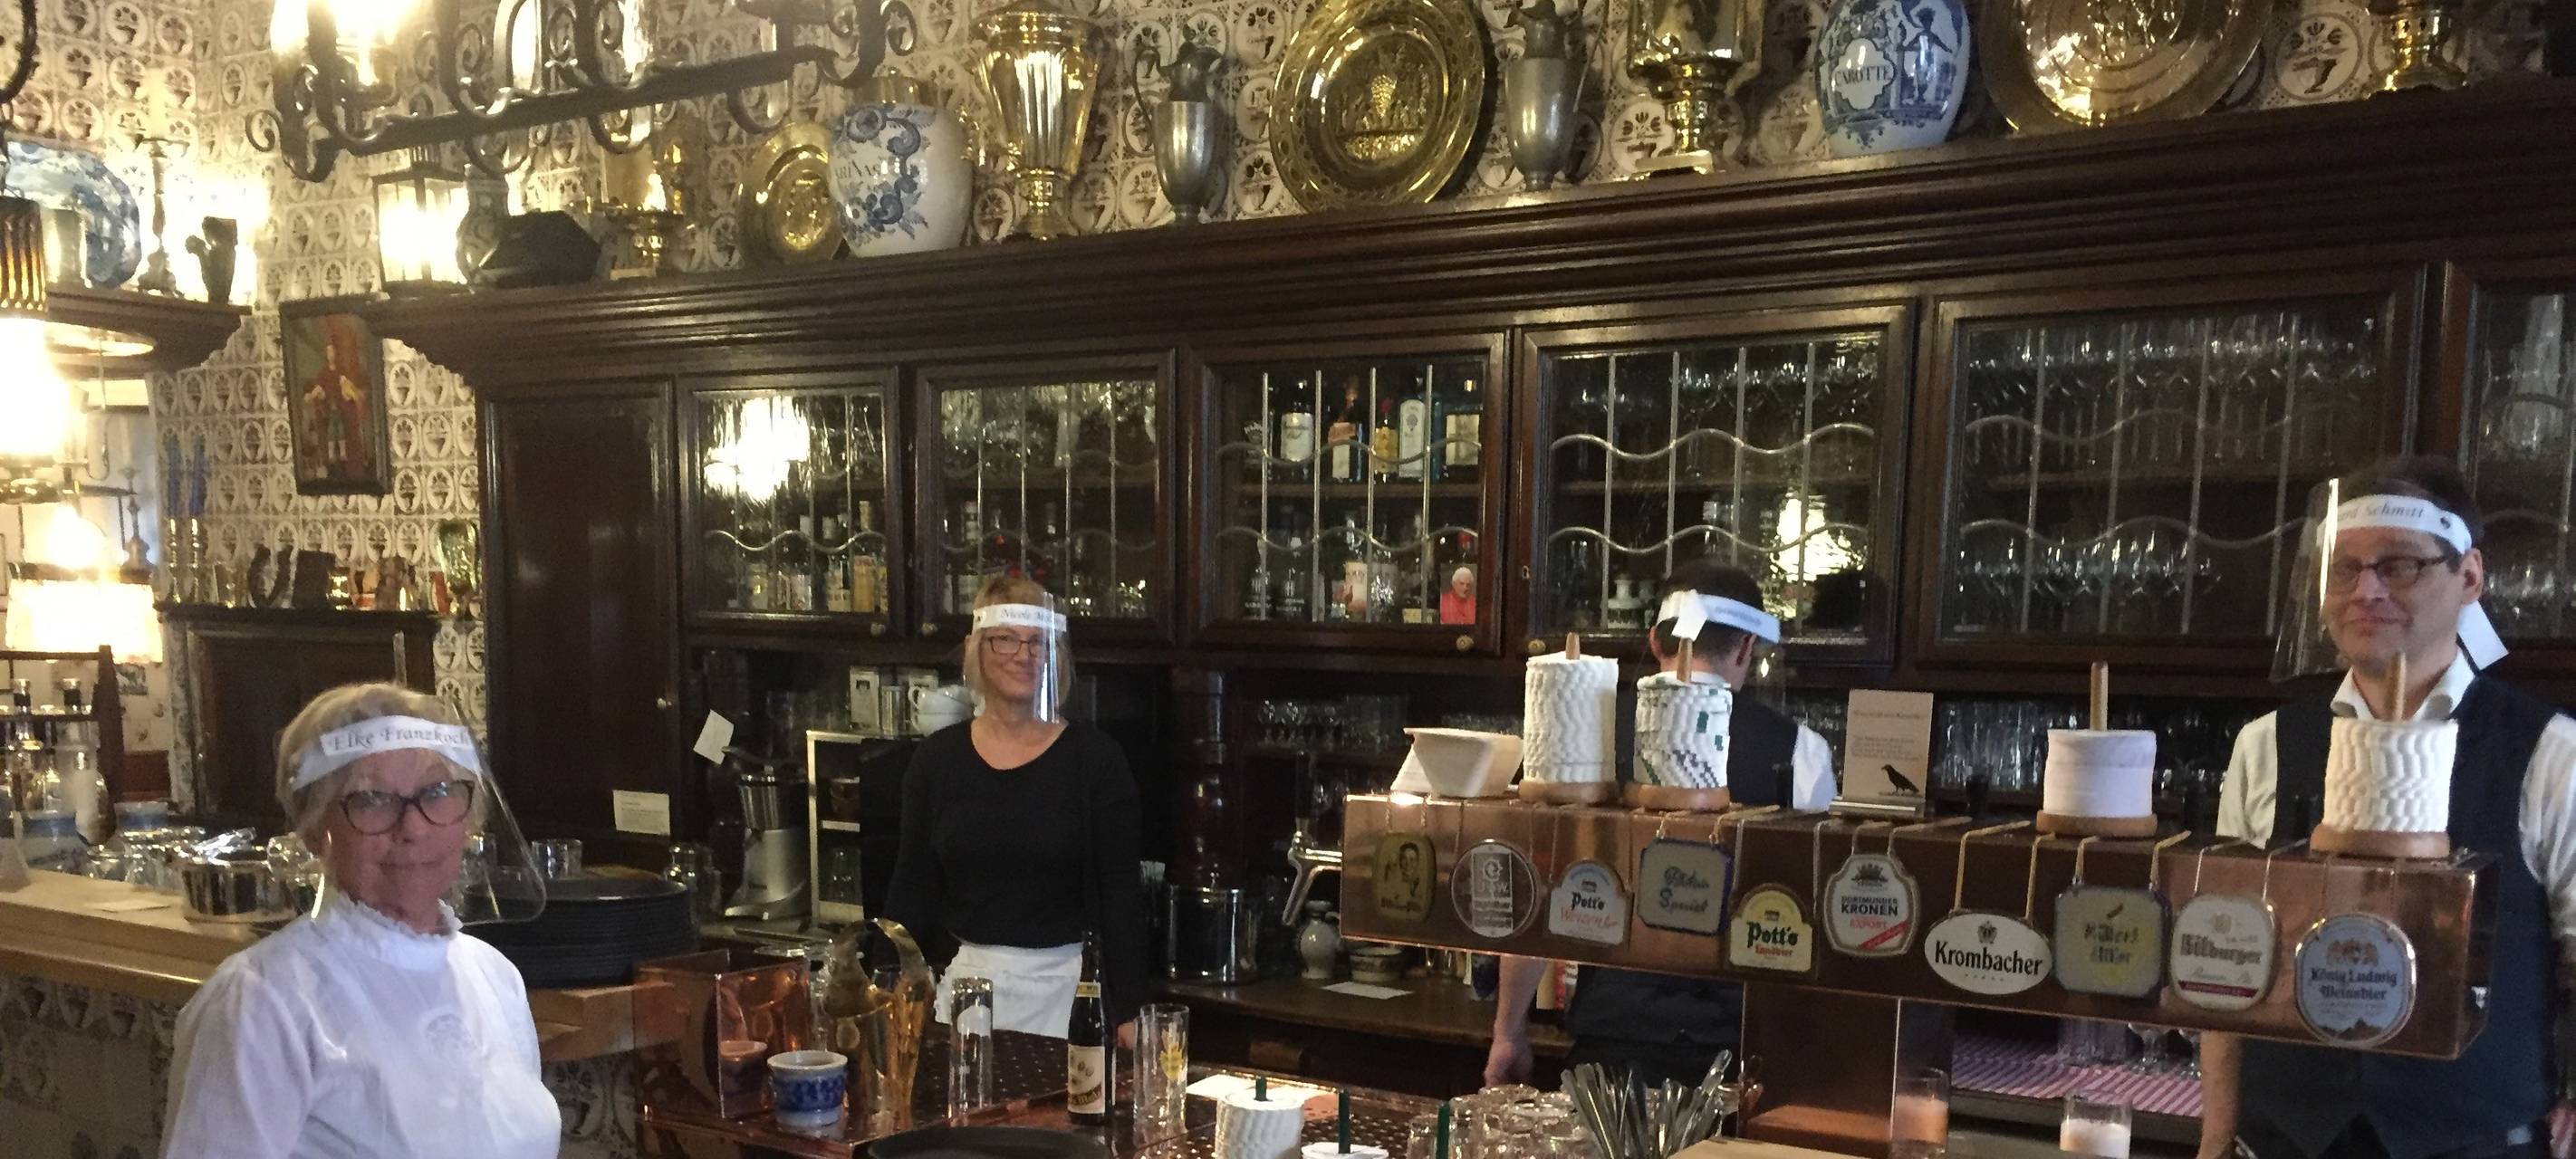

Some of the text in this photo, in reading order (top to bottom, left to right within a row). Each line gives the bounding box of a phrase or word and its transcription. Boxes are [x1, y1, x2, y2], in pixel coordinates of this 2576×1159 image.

[1835, 65, 1892, 86] CAROTTE
[330, 732, 374, 752] Elke
[1841, 896, 1898, 905] DORTMUNDER
[1841, 904, 1898, 916] KRONEN
[1935, 939, 2043, 976] Krombacher
[2349, 969, 2398, 987] Ludwig
